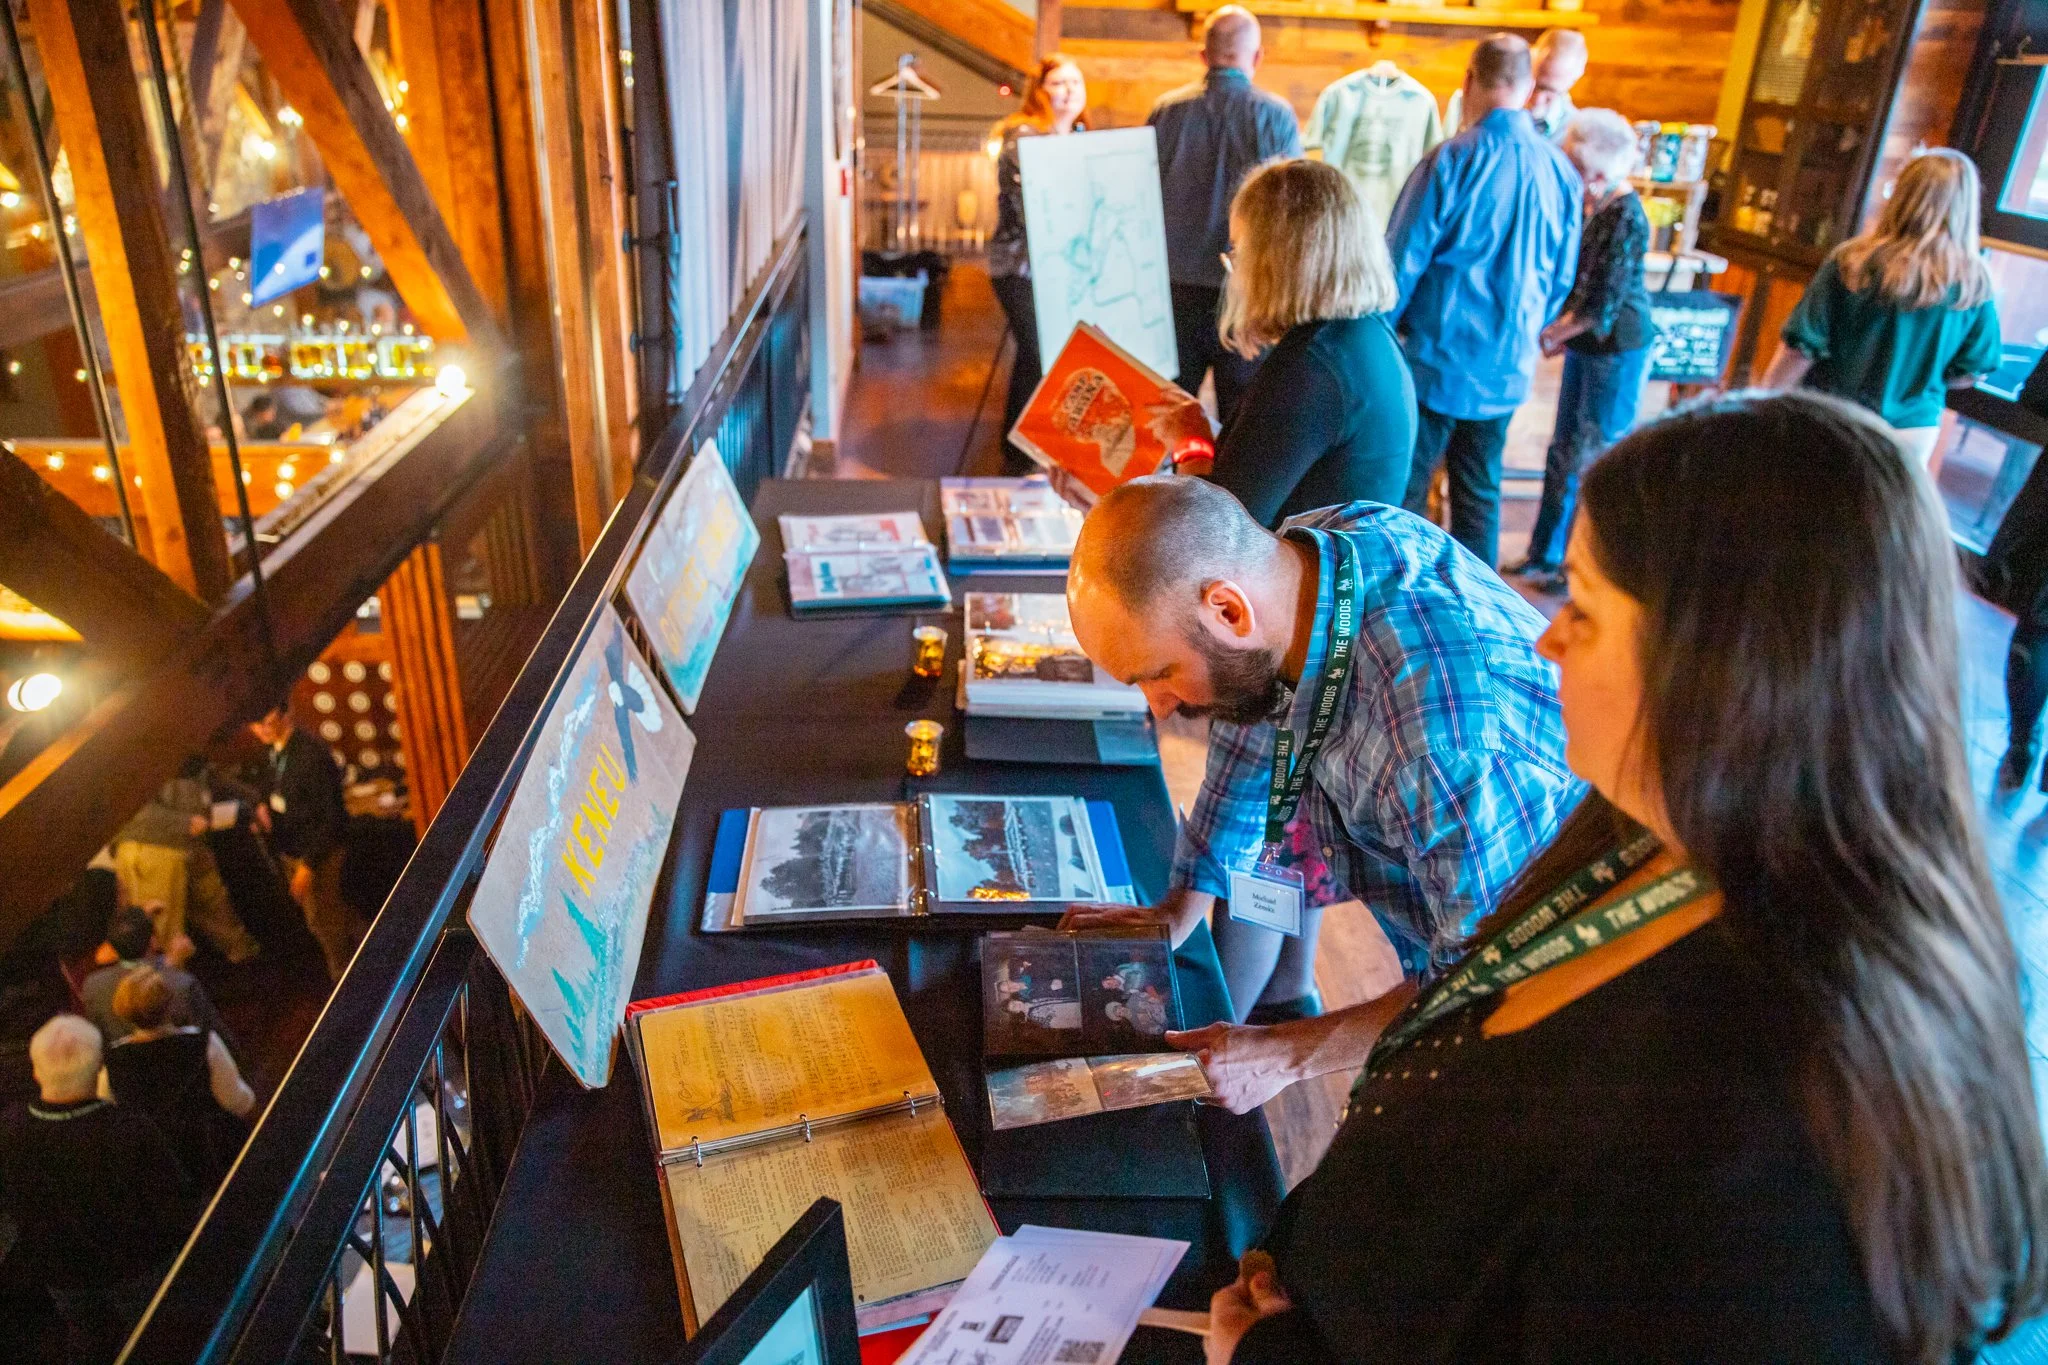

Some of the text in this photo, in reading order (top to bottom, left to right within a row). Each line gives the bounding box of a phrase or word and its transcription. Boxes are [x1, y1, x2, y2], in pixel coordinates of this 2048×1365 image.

[1333, 599, 1351, 659] THE WOODS
[1313, 685, 1337, 733] THE WOODS
[1274, 739, 1289, 790] THE WOODS
[1289, 775, 1304, 791] THE
[562, 743, 626, 897] KENEU
[1505, 884, 1588, 949] THE WOODS
